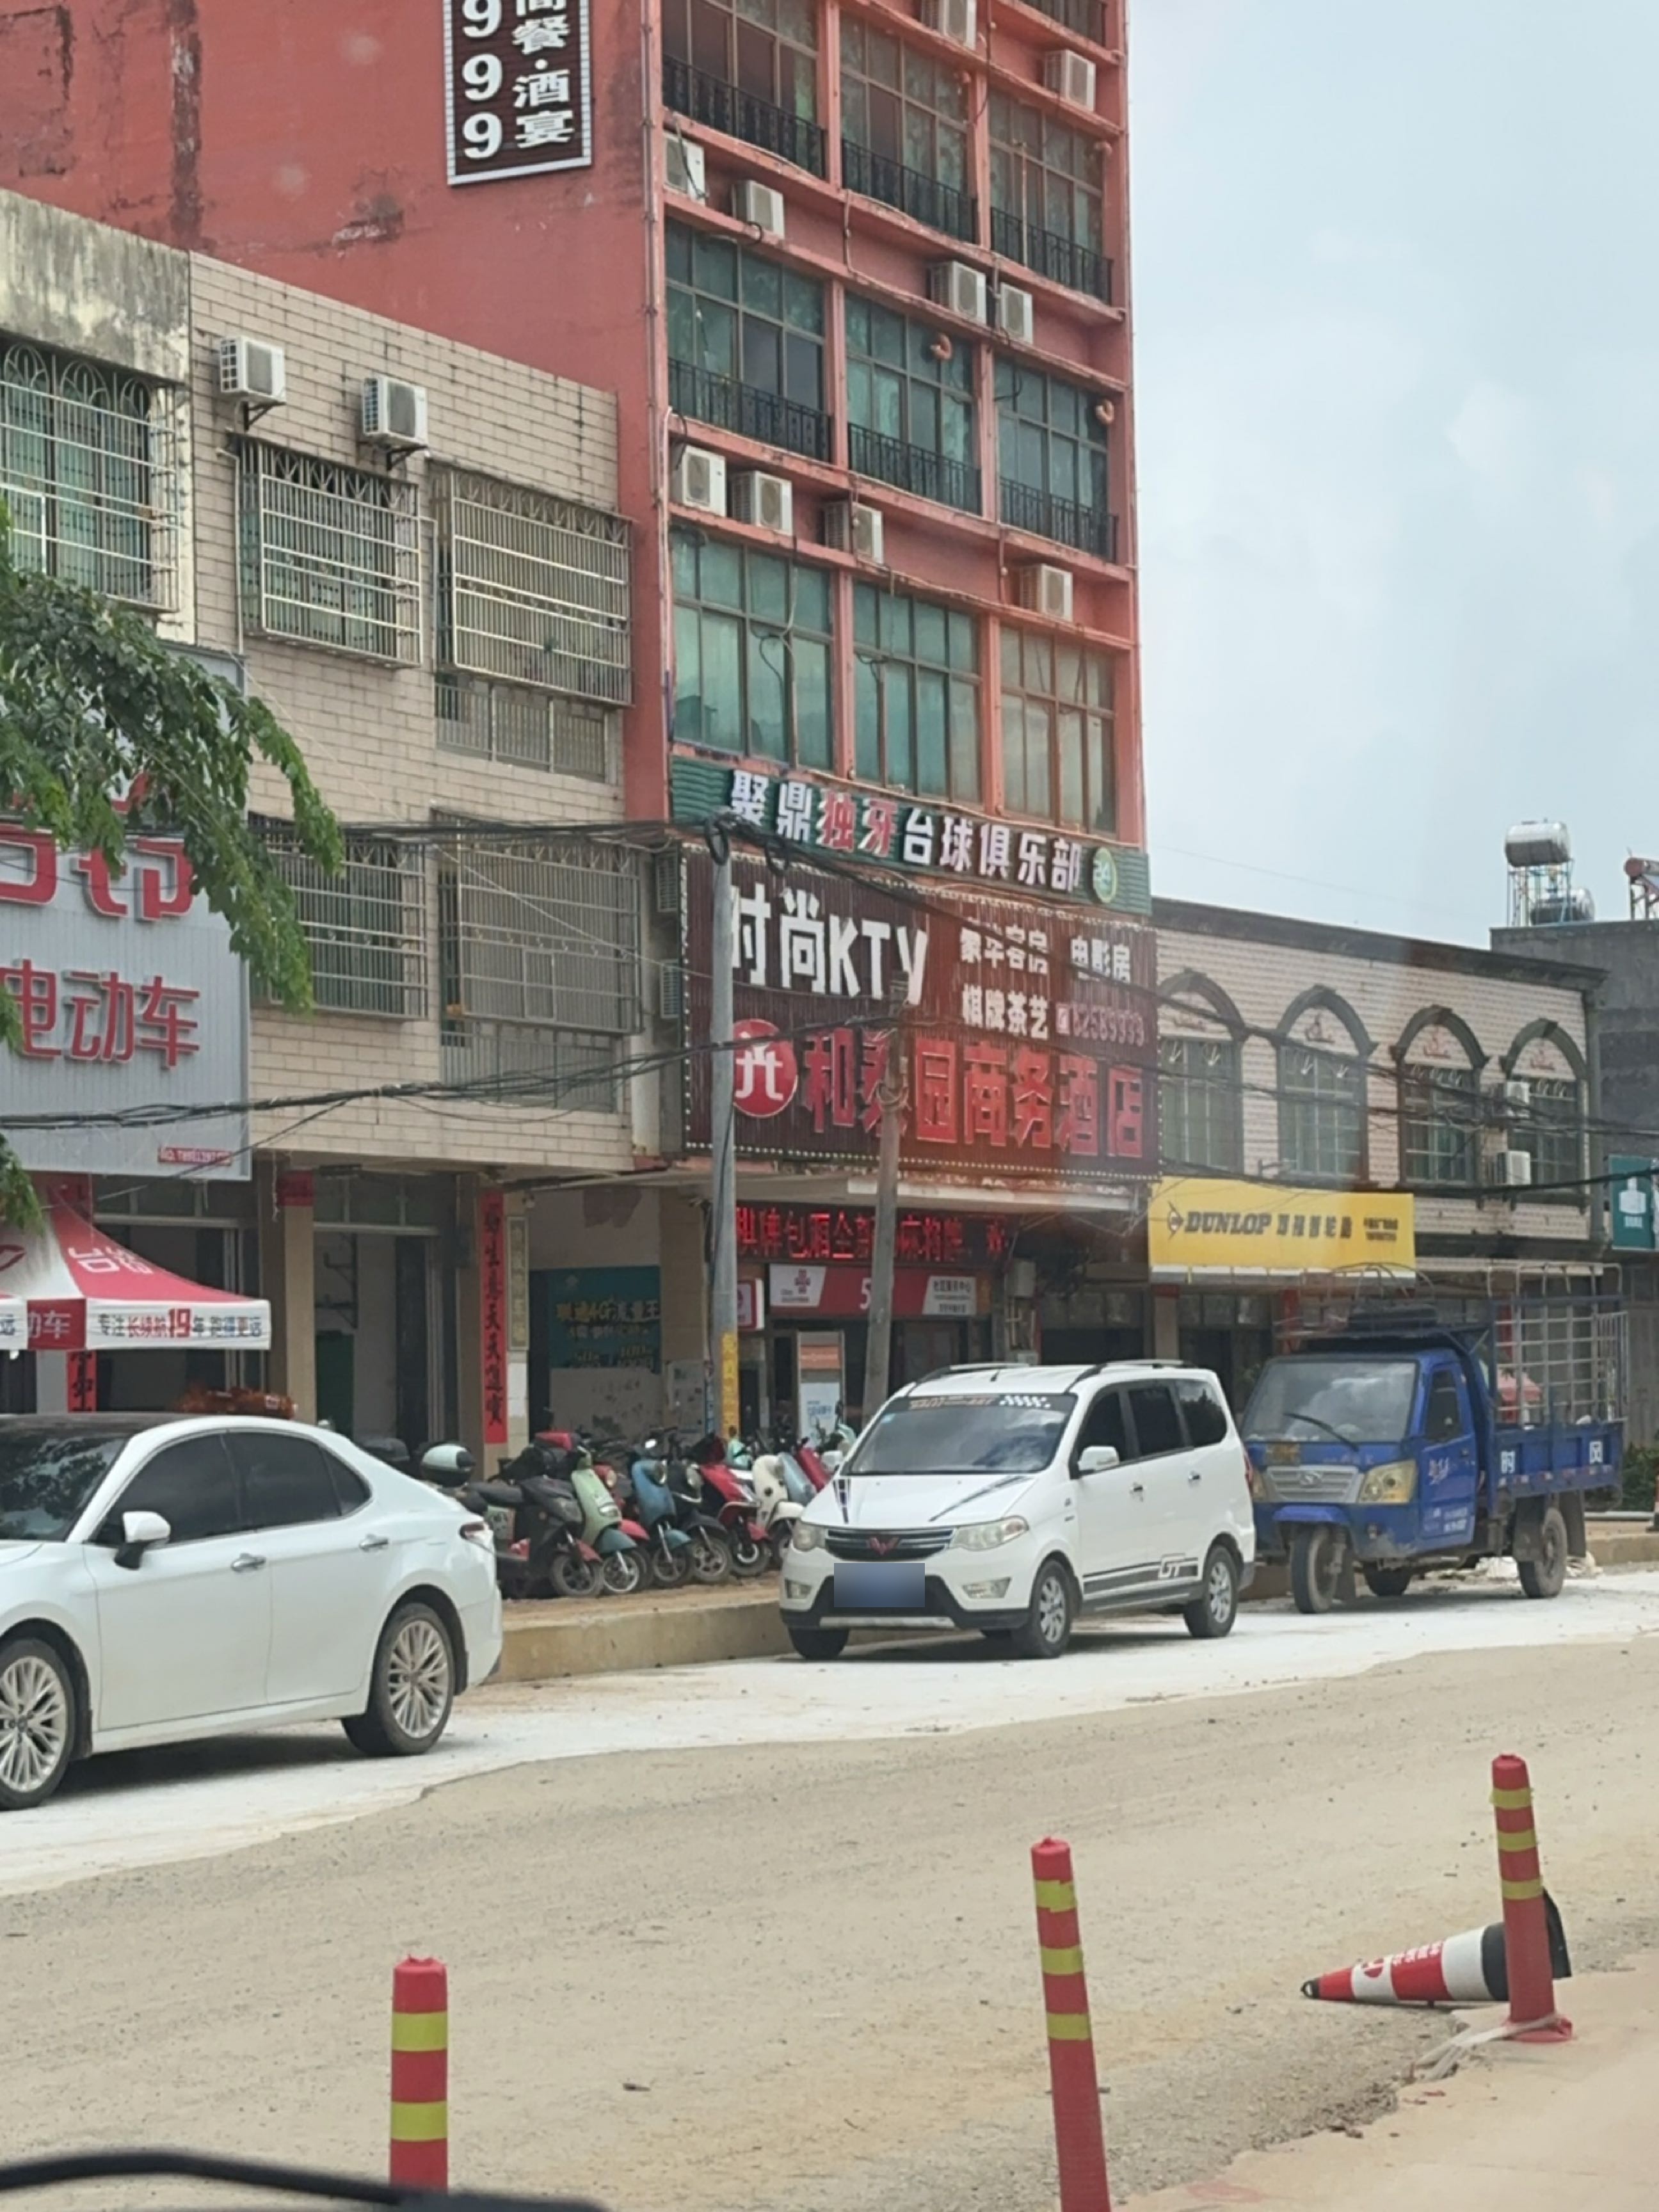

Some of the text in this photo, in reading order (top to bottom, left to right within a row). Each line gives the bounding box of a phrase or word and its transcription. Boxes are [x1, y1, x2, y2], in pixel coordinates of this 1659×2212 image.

[0, 958, 200, 1068] 电动车
[961, 984, 1049, 1040] 棋牌茶艺
[1184, 1210, 1272, 1236] DUNLOP
